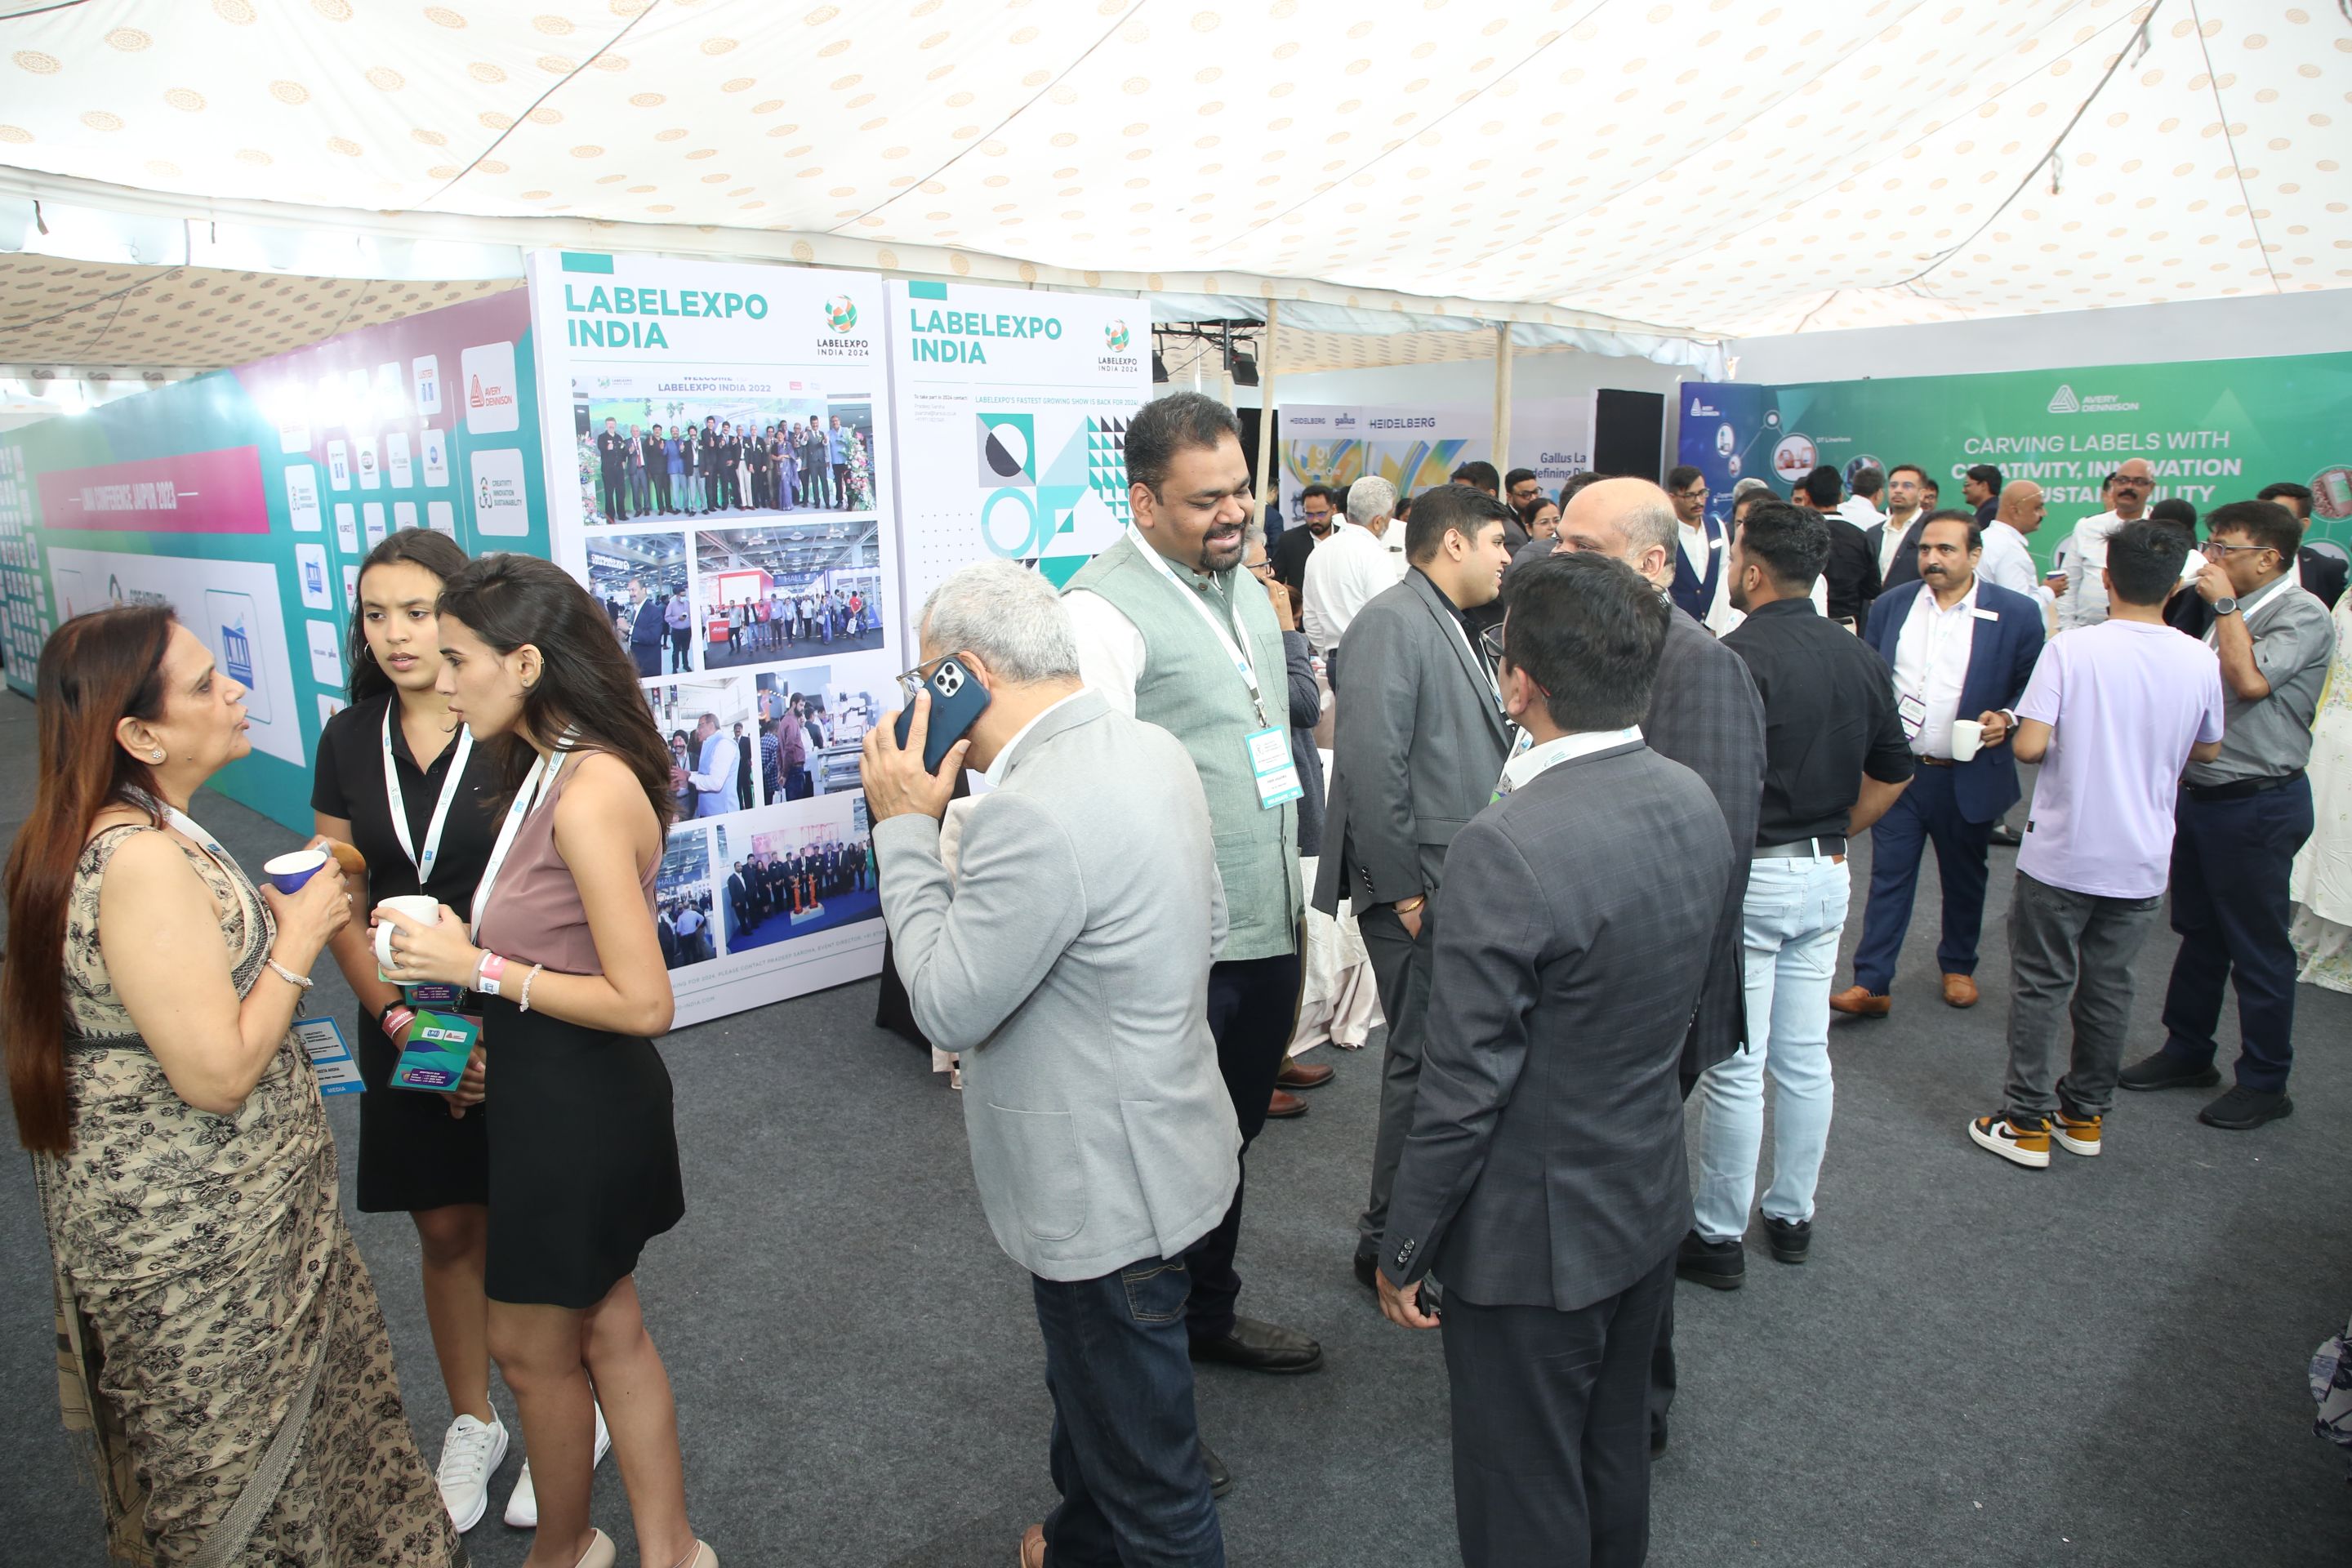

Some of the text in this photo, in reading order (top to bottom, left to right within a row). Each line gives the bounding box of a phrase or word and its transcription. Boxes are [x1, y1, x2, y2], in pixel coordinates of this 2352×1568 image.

[565, 284, 768, 320] LABELEXPO
[911, 308, 1062, 341] LABELEXPO
[568, 318, 670, 349] INDIA
[817, 339, 868, 348] LABELEXPO
[912, 338, 987, 364] INDIA
[1098, 357, 1138, 365] LABELEXPO
[484, 385, 501, 395] AVERY
[658, 383, 771, 393] LABELEXPO INDIA 2022
[485, 395, 513, 407] DENNISON
[2082, 394, 2118, 403] AVERY
[2082, 403, 2139, 412] DENNISON
[1370, 418, 1436, 429] HEIDELBERG
[1964, 430, 2230, 455] CARVING LABELS WITH
[1540, 452, 1586, 463] Gallus La
[1951, 458, 2242, 480] CATIVITY, INVATION
[156, 481, 176, 510] 2023
[804, 573, 810, 581] 3
[657, 876, 677, 888] HALL
[718, 968, 739, 977] PLEASE
[740, 960, 766, 971] CONTACT
